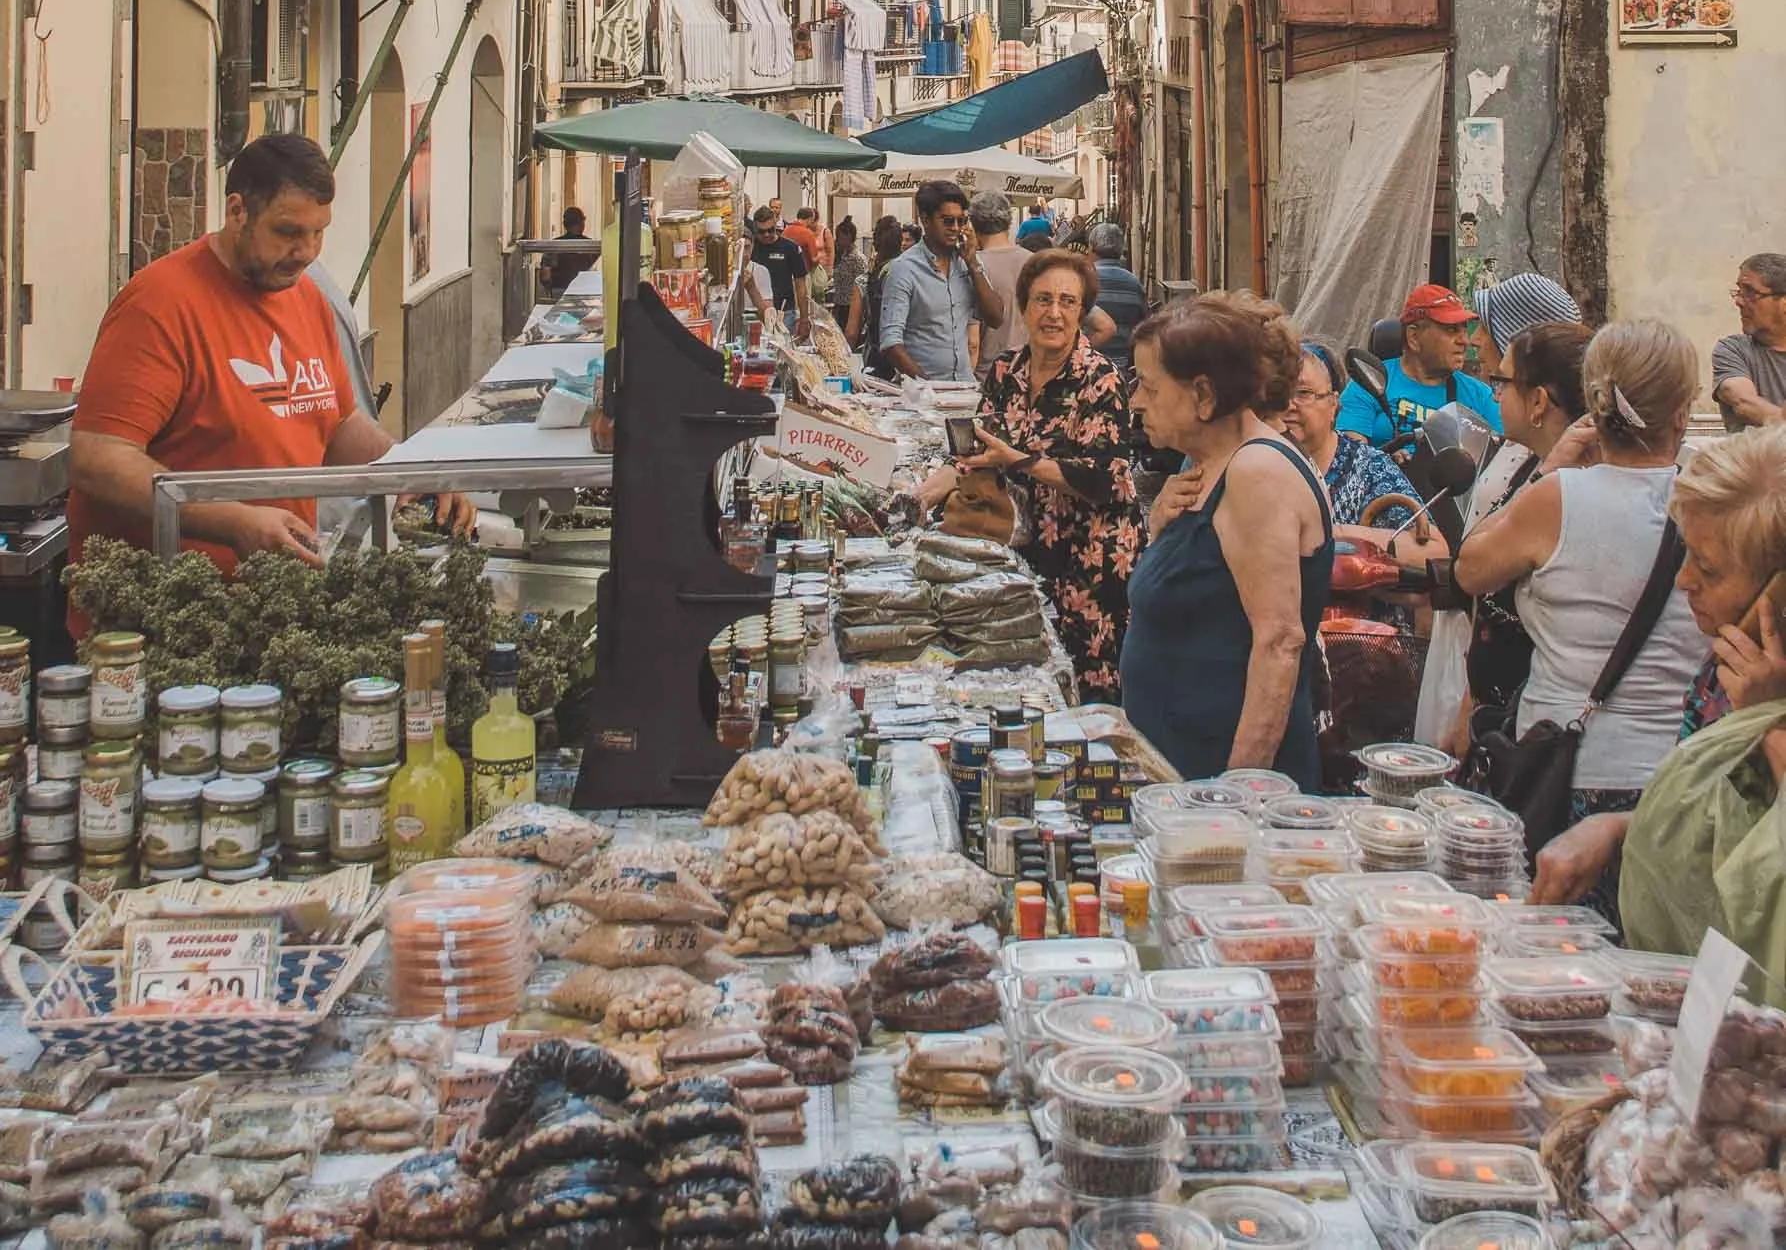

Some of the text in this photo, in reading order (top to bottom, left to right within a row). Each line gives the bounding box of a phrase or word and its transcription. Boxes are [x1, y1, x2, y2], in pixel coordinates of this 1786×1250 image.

[878, 172, 921, 190] Menabre
[1003, 175, 1054, 194] Menabrea
[291, 400, 314, 415] NEW
[788, 429, 870, 467] PITARRESI
[167, 933, 239, 945] ZAFFERANO
[170, 948, 232, 959] SICILIANO
